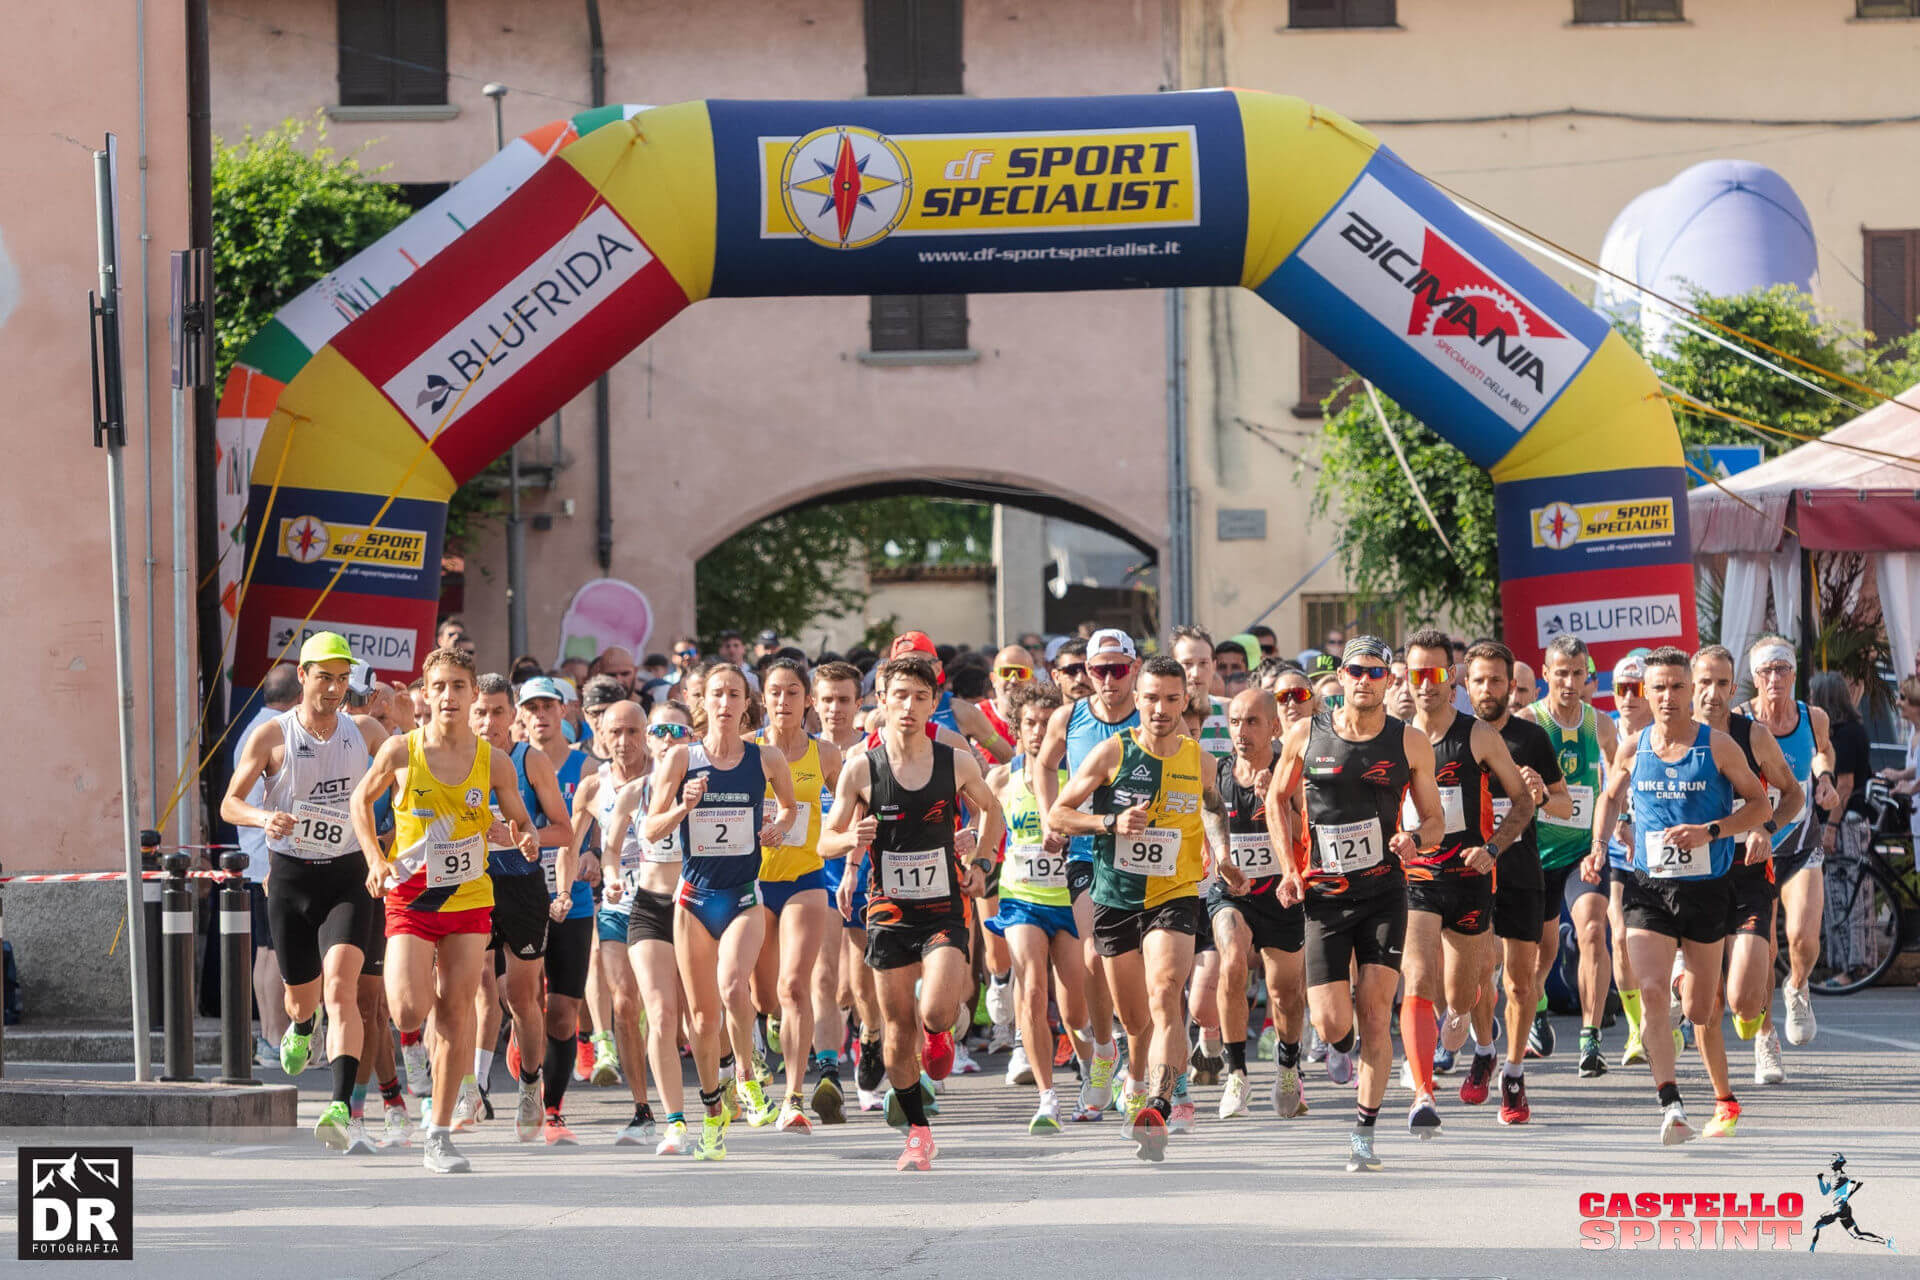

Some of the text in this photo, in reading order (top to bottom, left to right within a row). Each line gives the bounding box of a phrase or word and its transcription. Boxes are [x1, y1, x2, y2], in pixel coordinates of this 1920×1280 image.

[943, 142, 1180, 181] df SPORT
[920, 179, 1179, 218] SPECIALIST
[917, 240, 1181, 263] www.df-sportspecialist.it
[448, 234, 635, 384] BLUFRIDA
[1338, 210, 1545, 395] BICIMANIA
[1436, 338, 1530, 416] SPECIALISTI DELLA BICI
[1616, 504, 1669, 520] SPORT
[1585, 518, 1669, 536] SPECIALIST
[365, 533, 423, 549] SPORT
[331, 544, 420, 563] SPECIALIST
[1569, 604, 1679, 633] BLUFRIDA
[310, 777, 351, 796] AGT
[1637, 779, 1707, 792] BIKE & RUN
[1656, 791, 1687, 800] CREMA
[301, 818, 343, 844] 188
[715, 823, 729, 843] 2
[1132, 842, 1163, 863] 98
[1231, 847, 1273, 867] 123
[1329, 836, 1372, 861] 121
[1663, 846, 1693, 866] 28
[444, 851, 471, 874] 93
[1025, 858, 1065, 877] 192
[893, 865, 937, 887] 117
